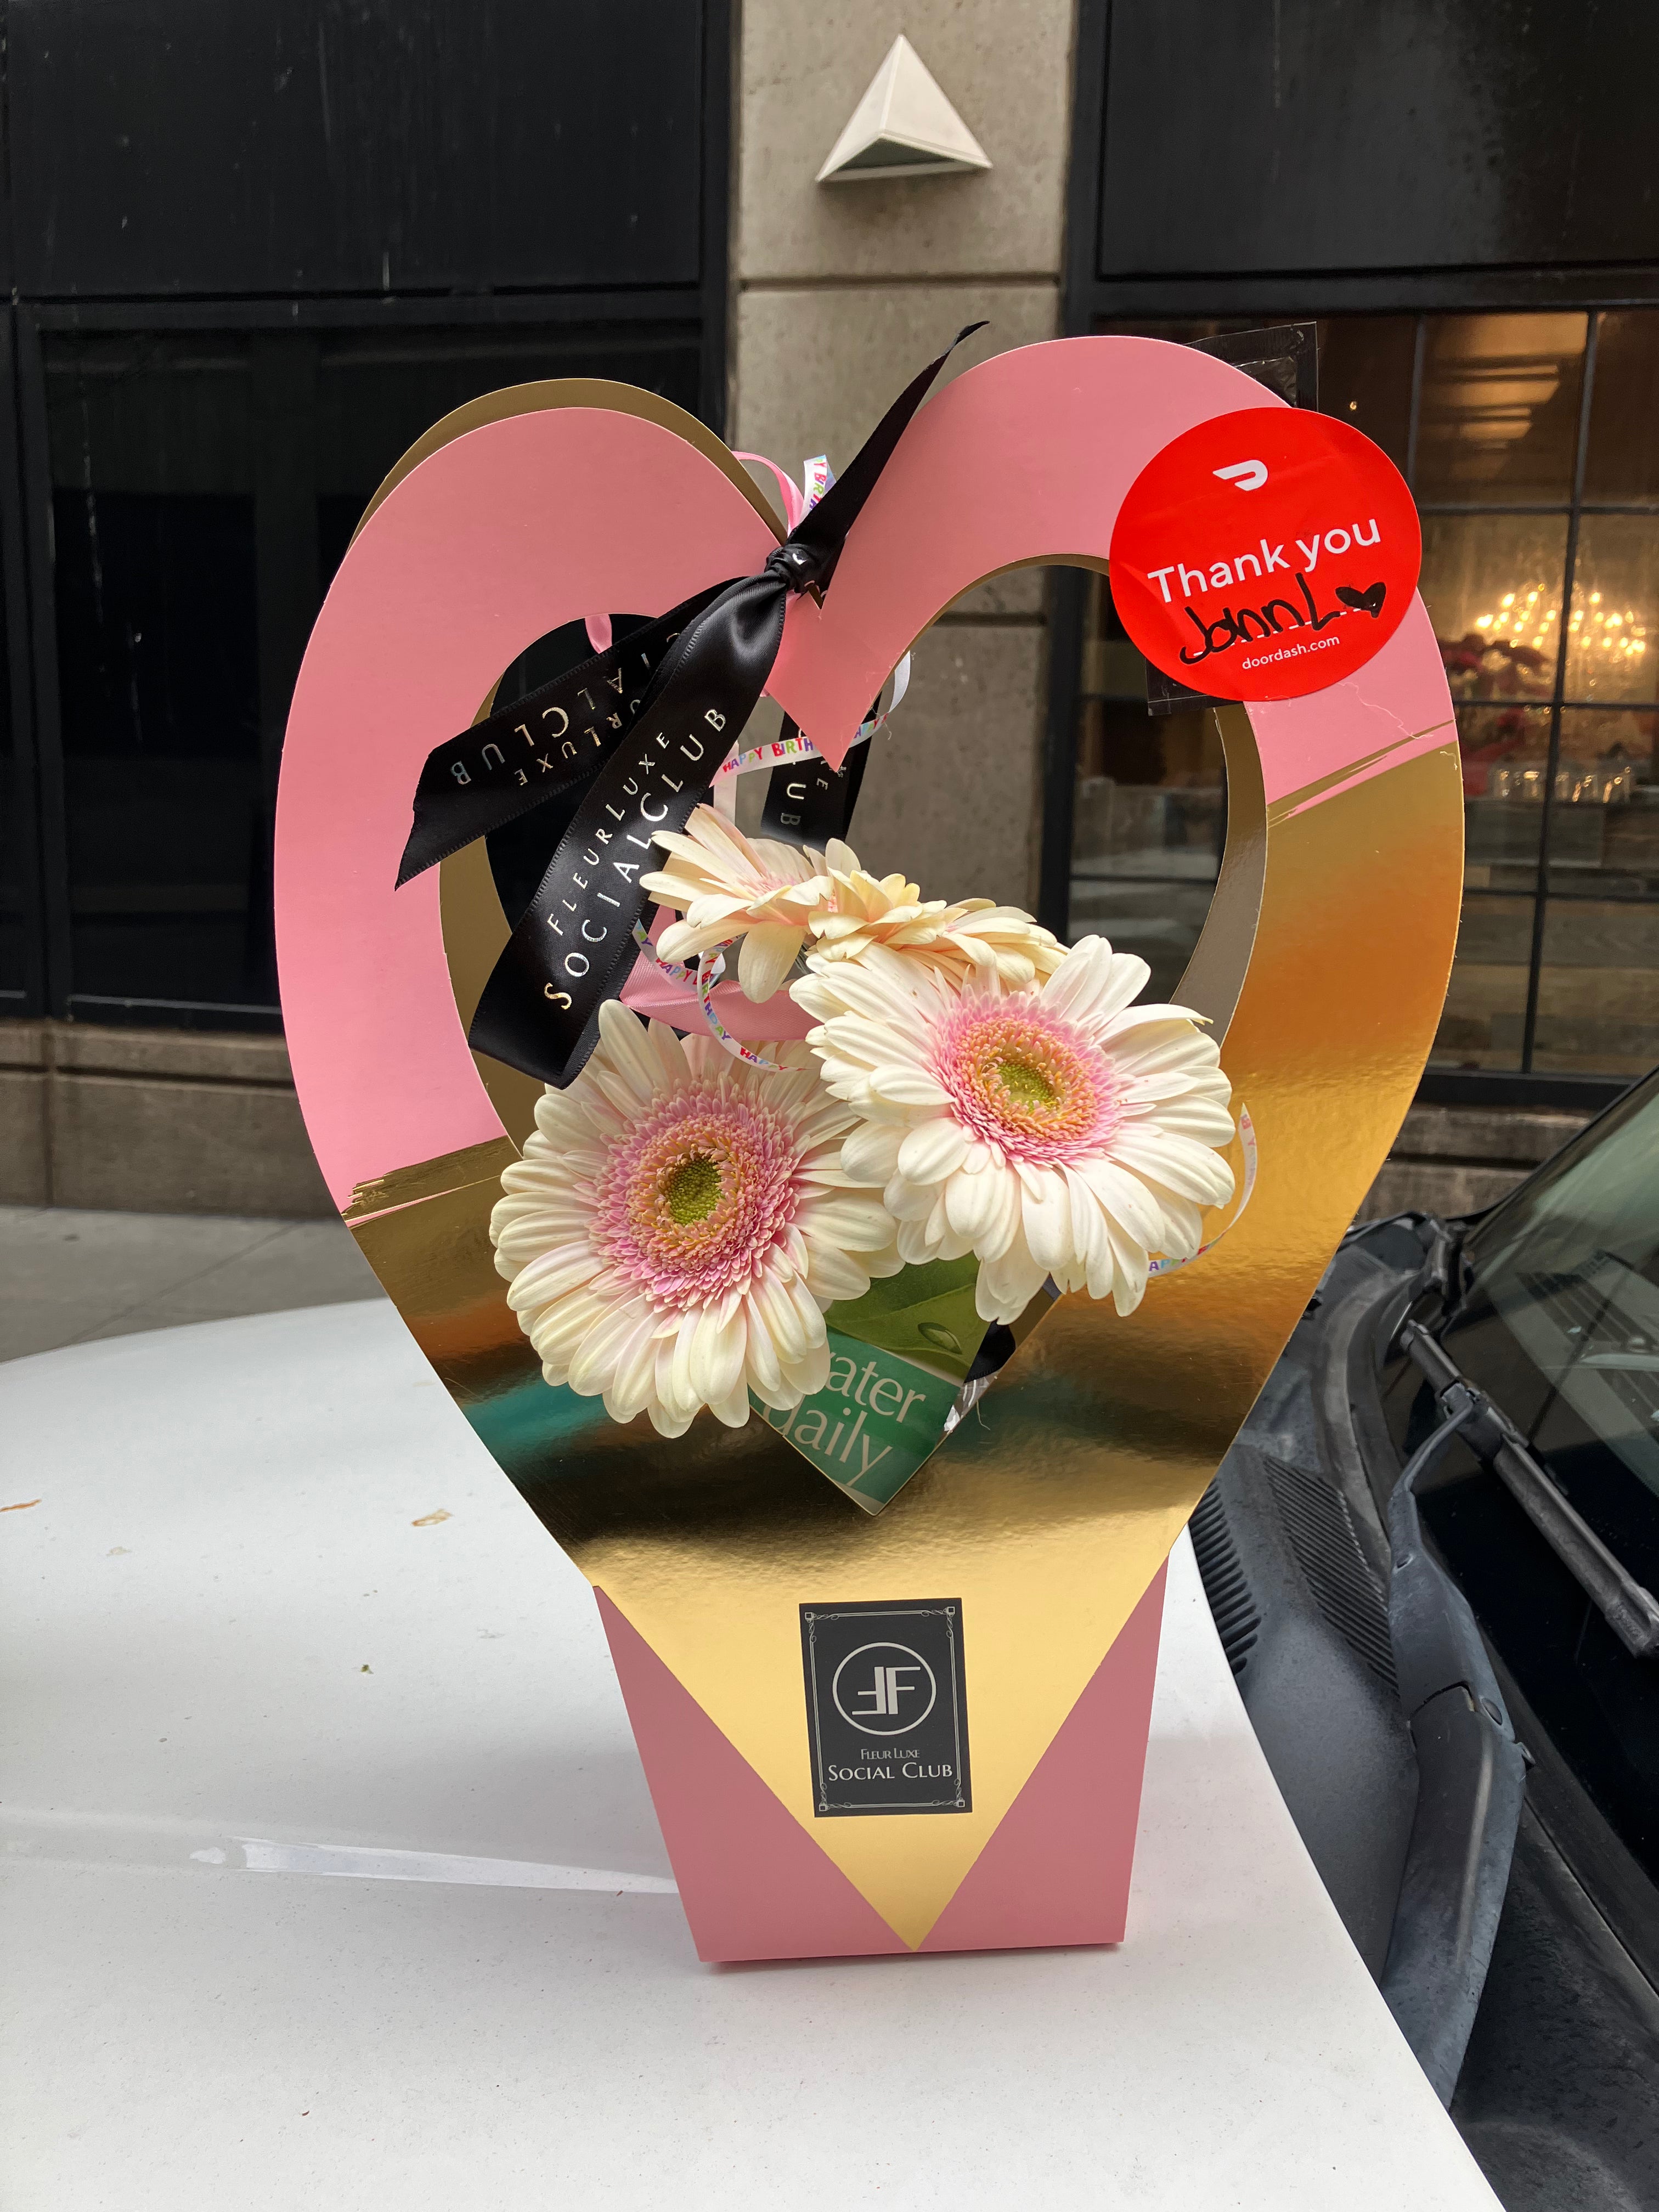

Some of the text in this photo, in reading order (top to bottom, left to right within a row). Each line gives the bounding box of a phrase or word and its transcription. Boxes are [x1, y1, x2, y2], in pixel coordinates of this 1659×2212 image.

[1147, 518, 1381, 603] Thank you
[1242, 635, 1340, 670] doordash.com
[450, 707, 569, 785] CLUB
[723, 746, 763, 772] HAPPY
[544, 708, 727, 1010] SOCIAL CLUB
[546, 731, 670, 936] FLEUR LUXE
[825, 1352, 927, 1423] ater
[828, 1762, 953, 1782] SOCIAL CLUB
